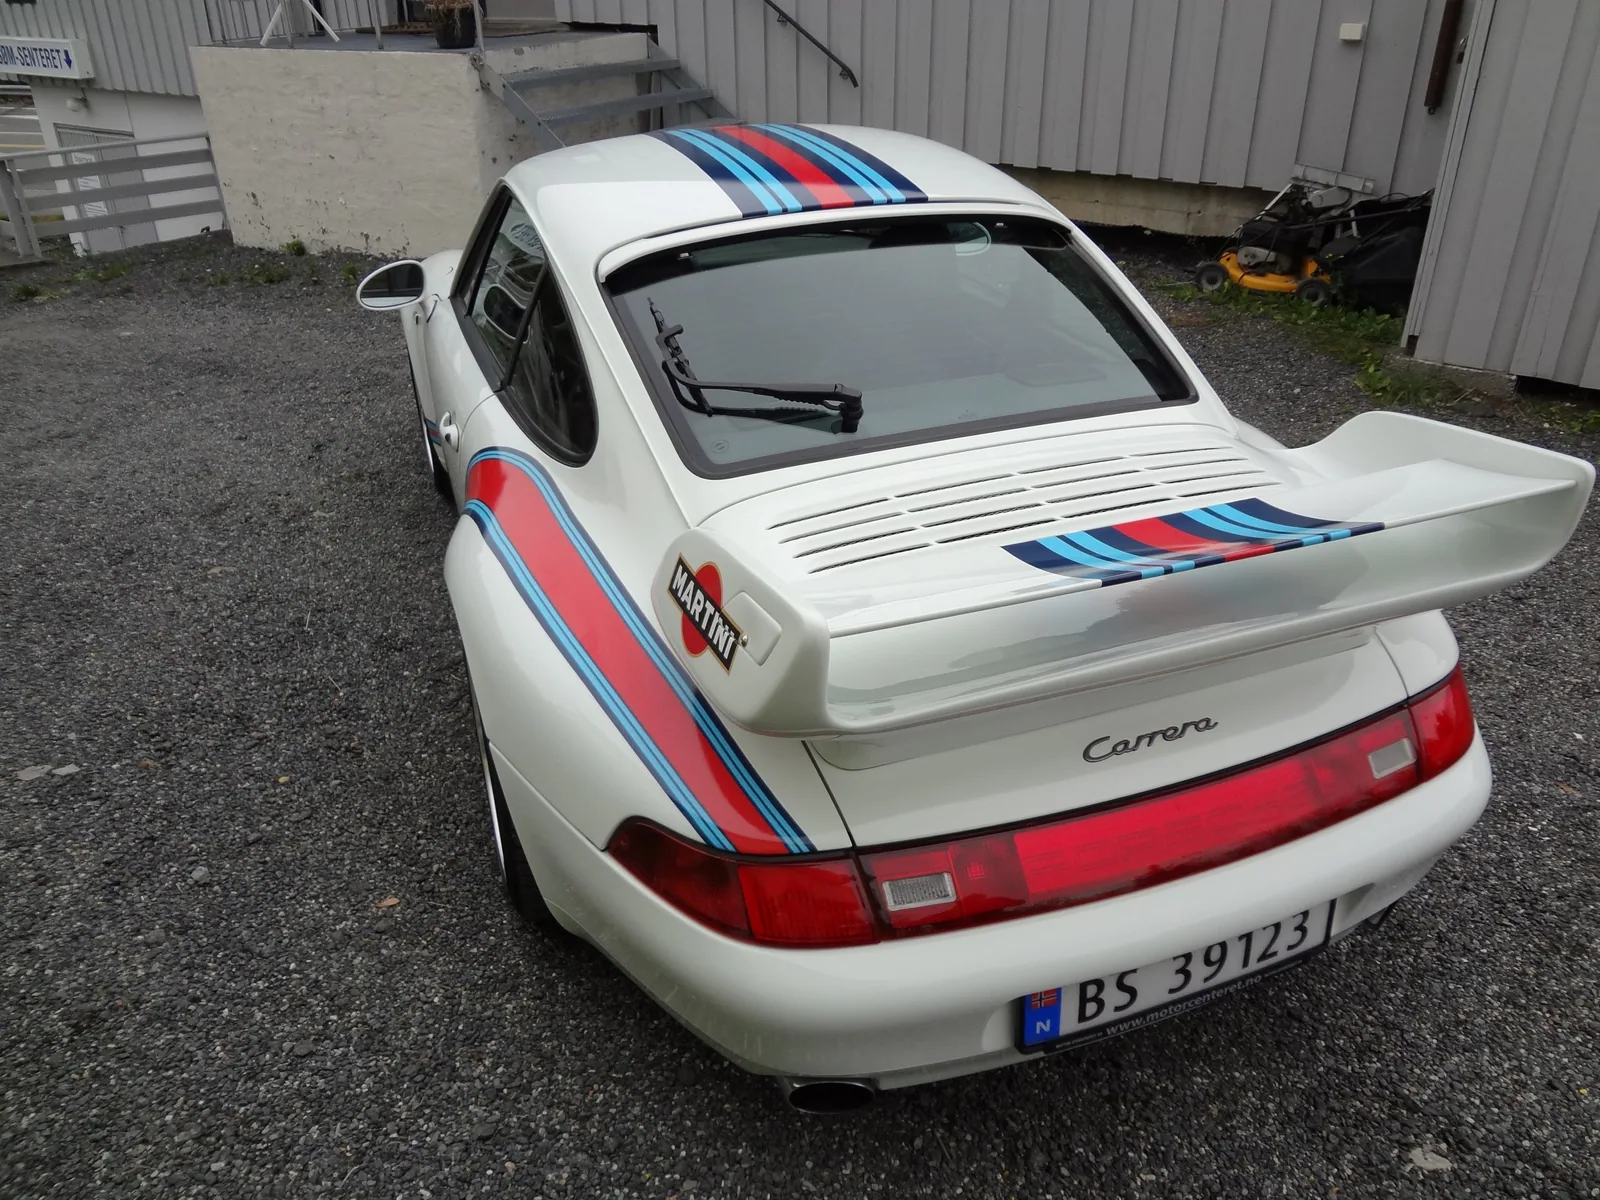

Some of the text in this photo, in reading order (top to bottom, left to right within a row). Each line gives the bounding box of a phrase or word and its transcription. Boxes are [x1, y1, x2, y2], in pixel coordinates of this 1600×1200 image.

[672, 564, 736, 660] MARTINI
[1082, 717, 1219, 763] Carrera
[1077, 909, 1310, 1024] BS 39123
[1035, 1018, 1051, 1035] N
[1105, 974, 1262, 1037] www.motorcenteret.no
